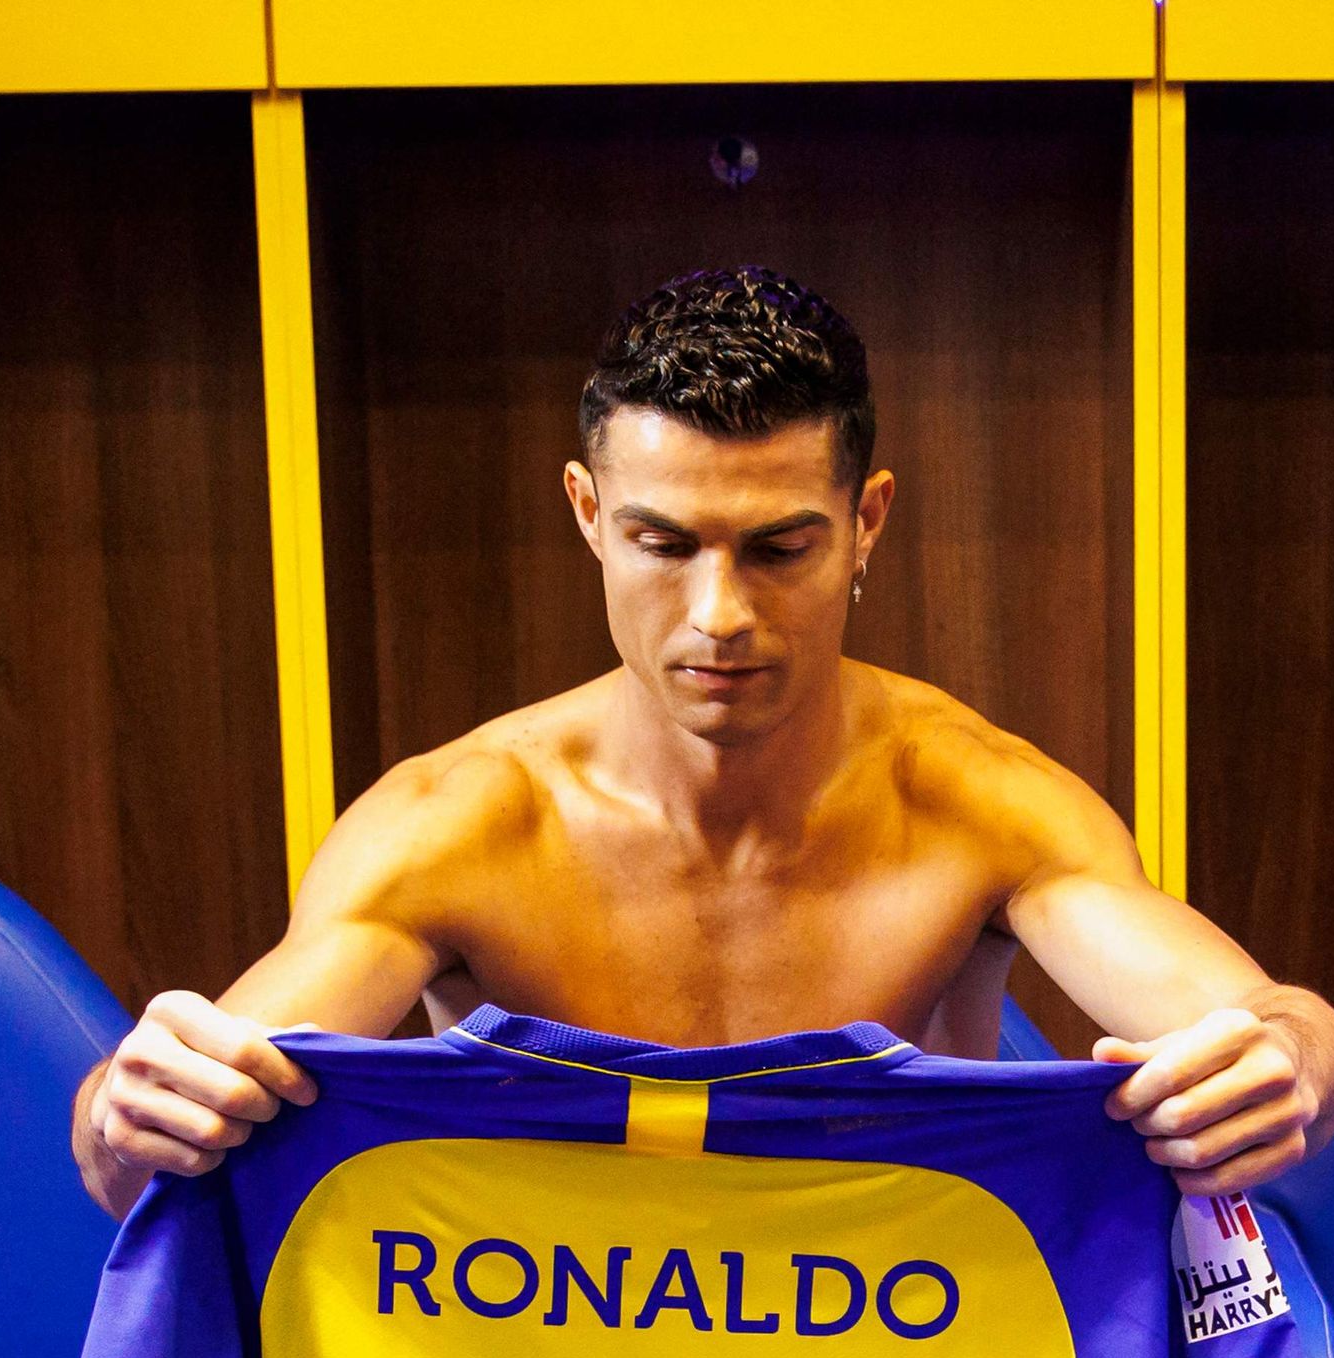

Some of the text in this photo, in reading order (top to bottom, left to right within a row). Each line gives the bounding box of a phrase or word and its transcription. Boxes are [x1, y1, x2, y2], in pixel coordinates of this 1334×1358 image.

[372, 1229, 960, 1340] RONALDO
[1178, 1258, 1252, 1309] بيتزا
[1188, 1286, 1291, 1340] HARRY'
